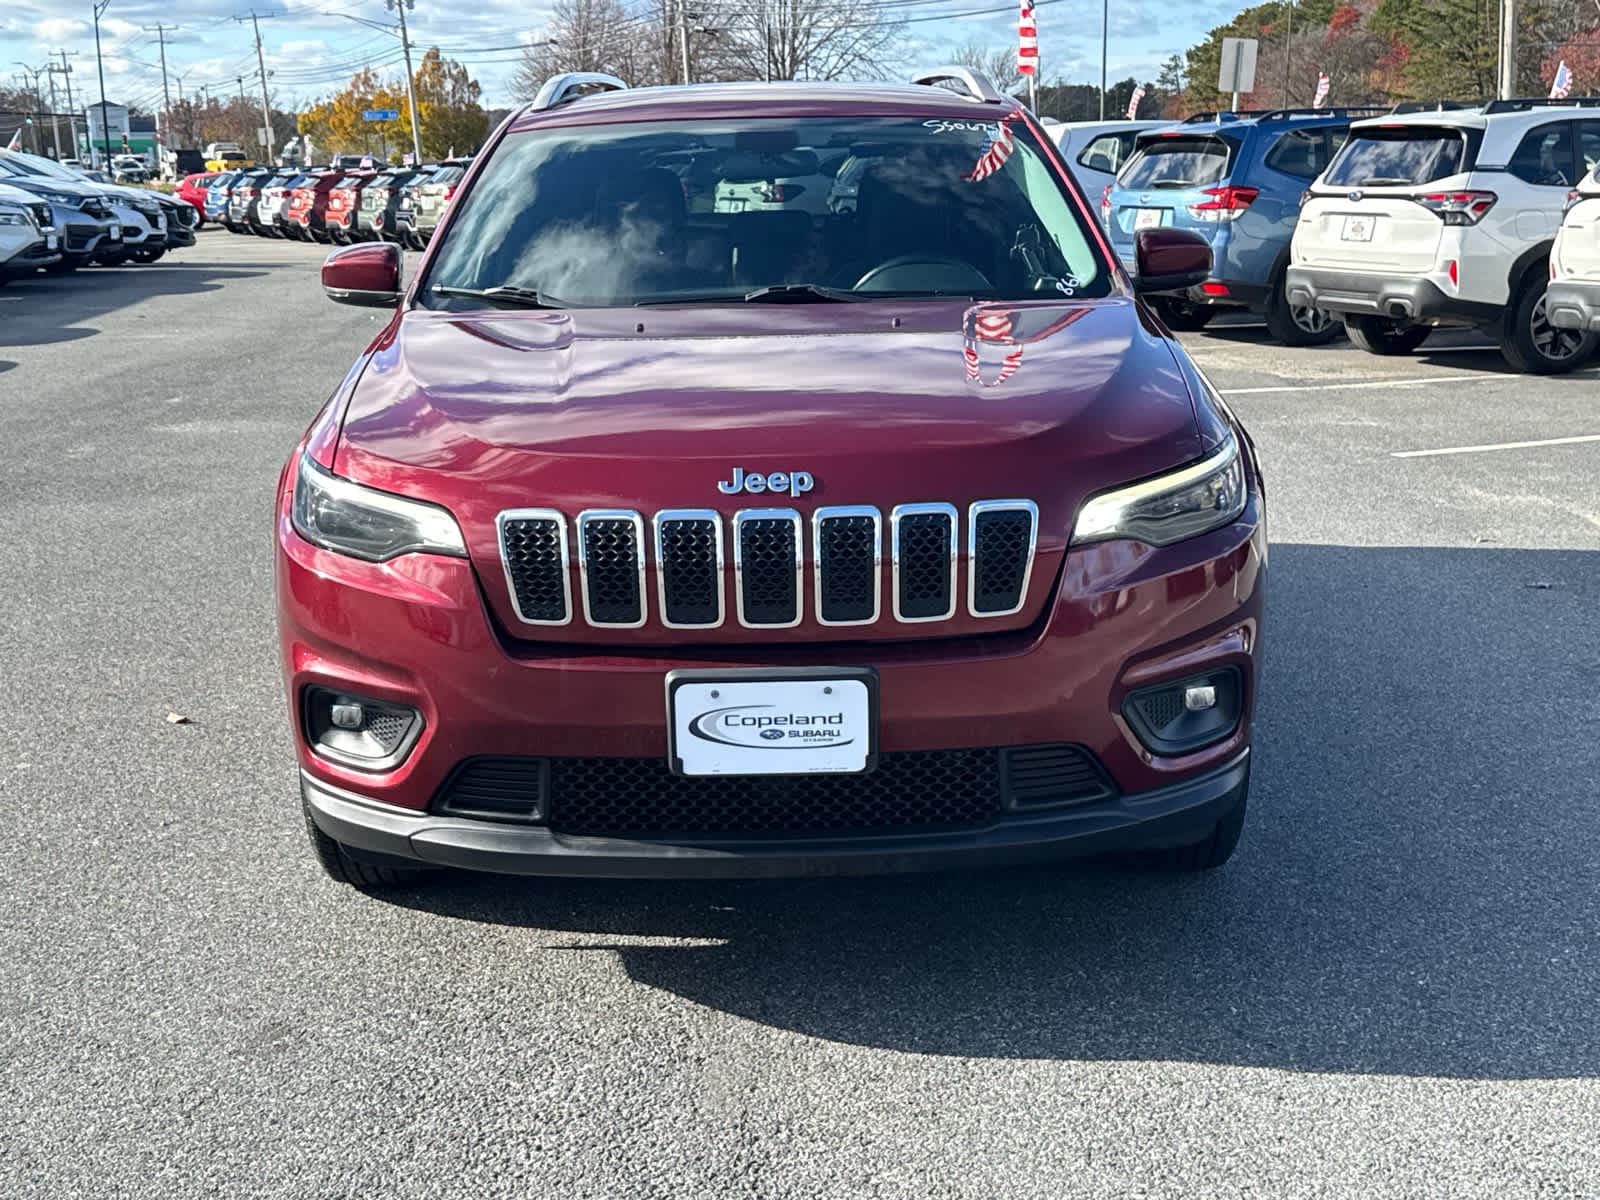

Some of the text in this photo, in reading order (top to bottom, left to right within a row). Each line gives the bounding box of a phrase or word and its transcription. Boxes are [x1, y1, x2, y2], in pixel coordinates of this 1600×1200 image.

[717, 467, 814, 497] Jeep
[725, 713, 842, 728] Copeland
[788, 729, 841, 738] SUBARU
